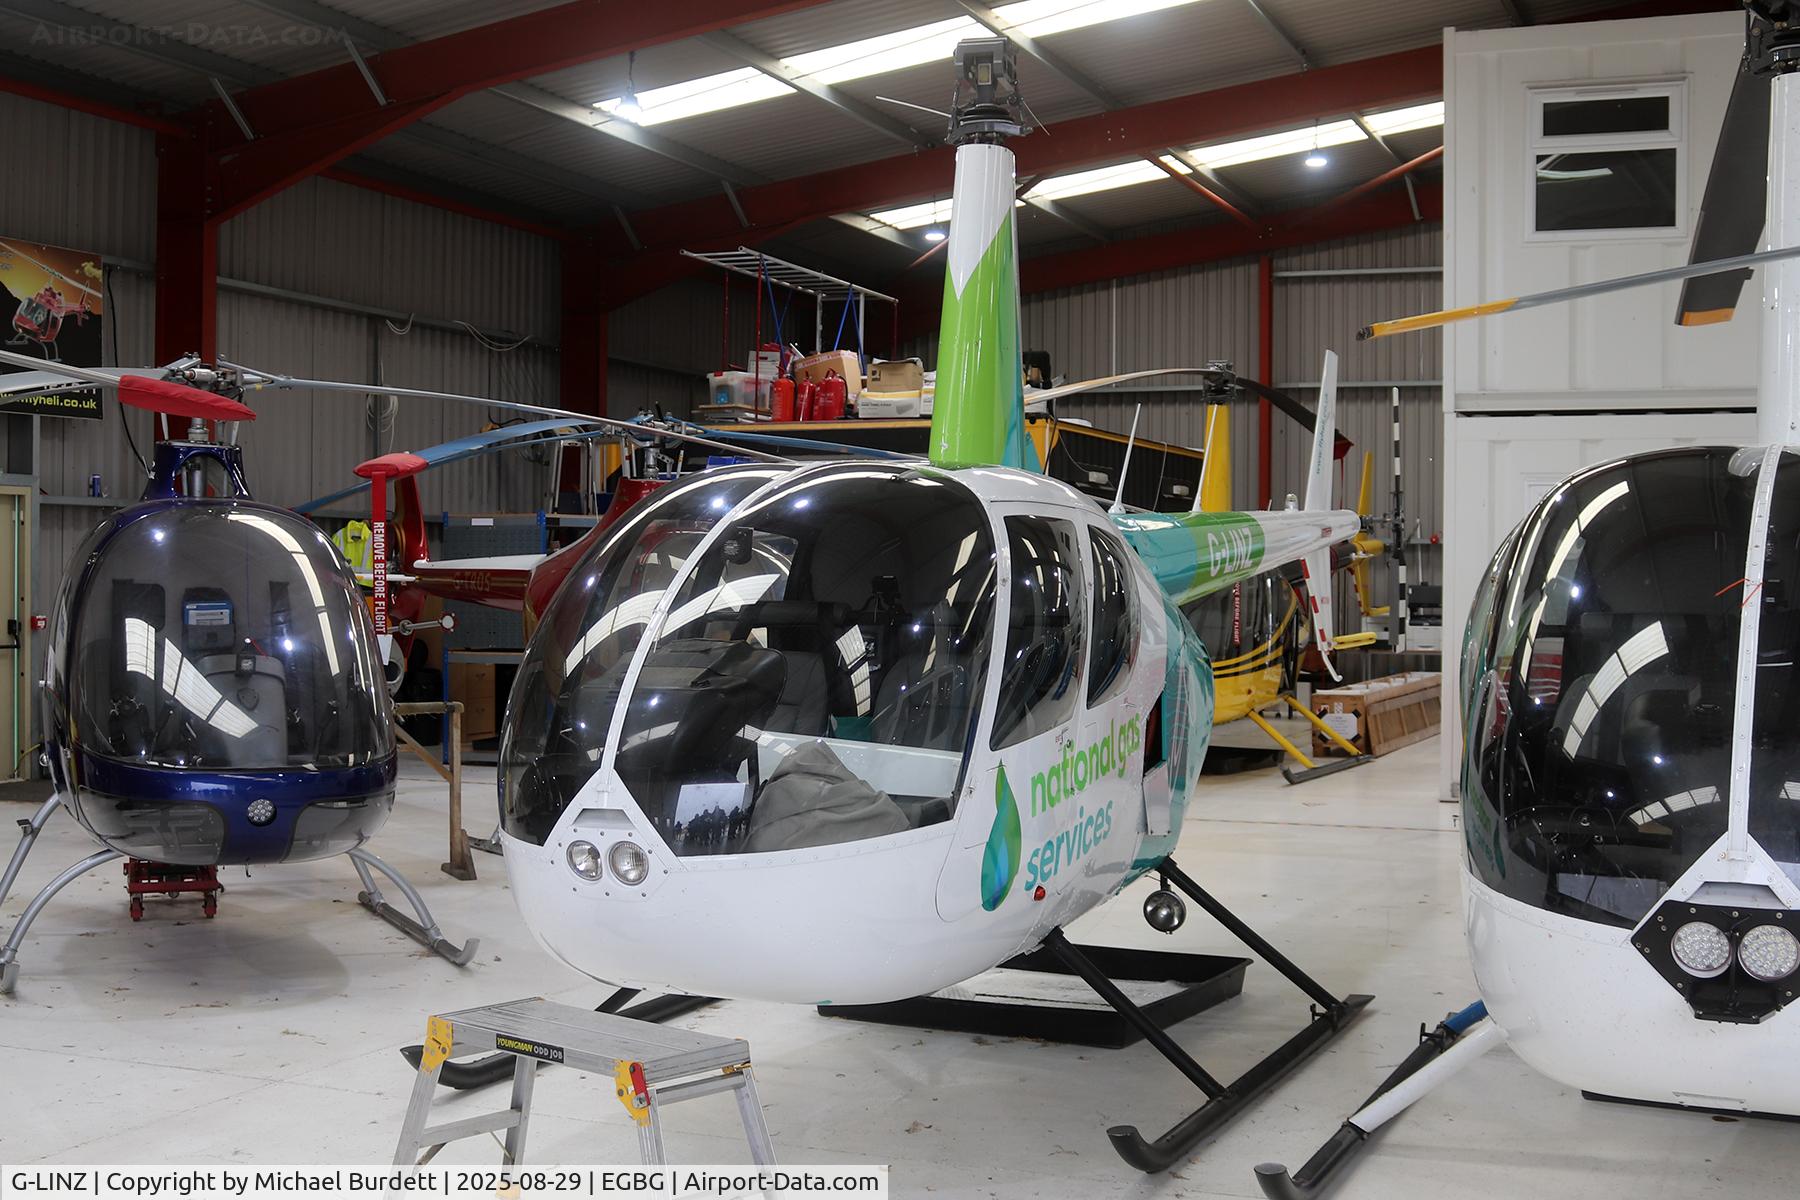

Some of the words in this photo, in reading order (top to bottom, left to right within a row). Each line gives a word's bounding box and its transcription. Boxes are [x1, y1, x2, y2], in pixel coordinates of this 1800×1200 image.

[373, 521, 385, 560] REMOVE
[1207, 526, 1253, 577] G-LINZ
[374, 562, 385, 598] BEFORE
[375, 600, 386, 633] FLIGHT
[1031, 718, 1116, 817] national
[1118, 712, 1141, 778] gas
[1024, 800, 1113, 891] services
[497, 1037, 533, 1053] YOUNGMAN
[533, 1045, 549, 1056] ODD
[549, 1049, 563, 1060] JOB
